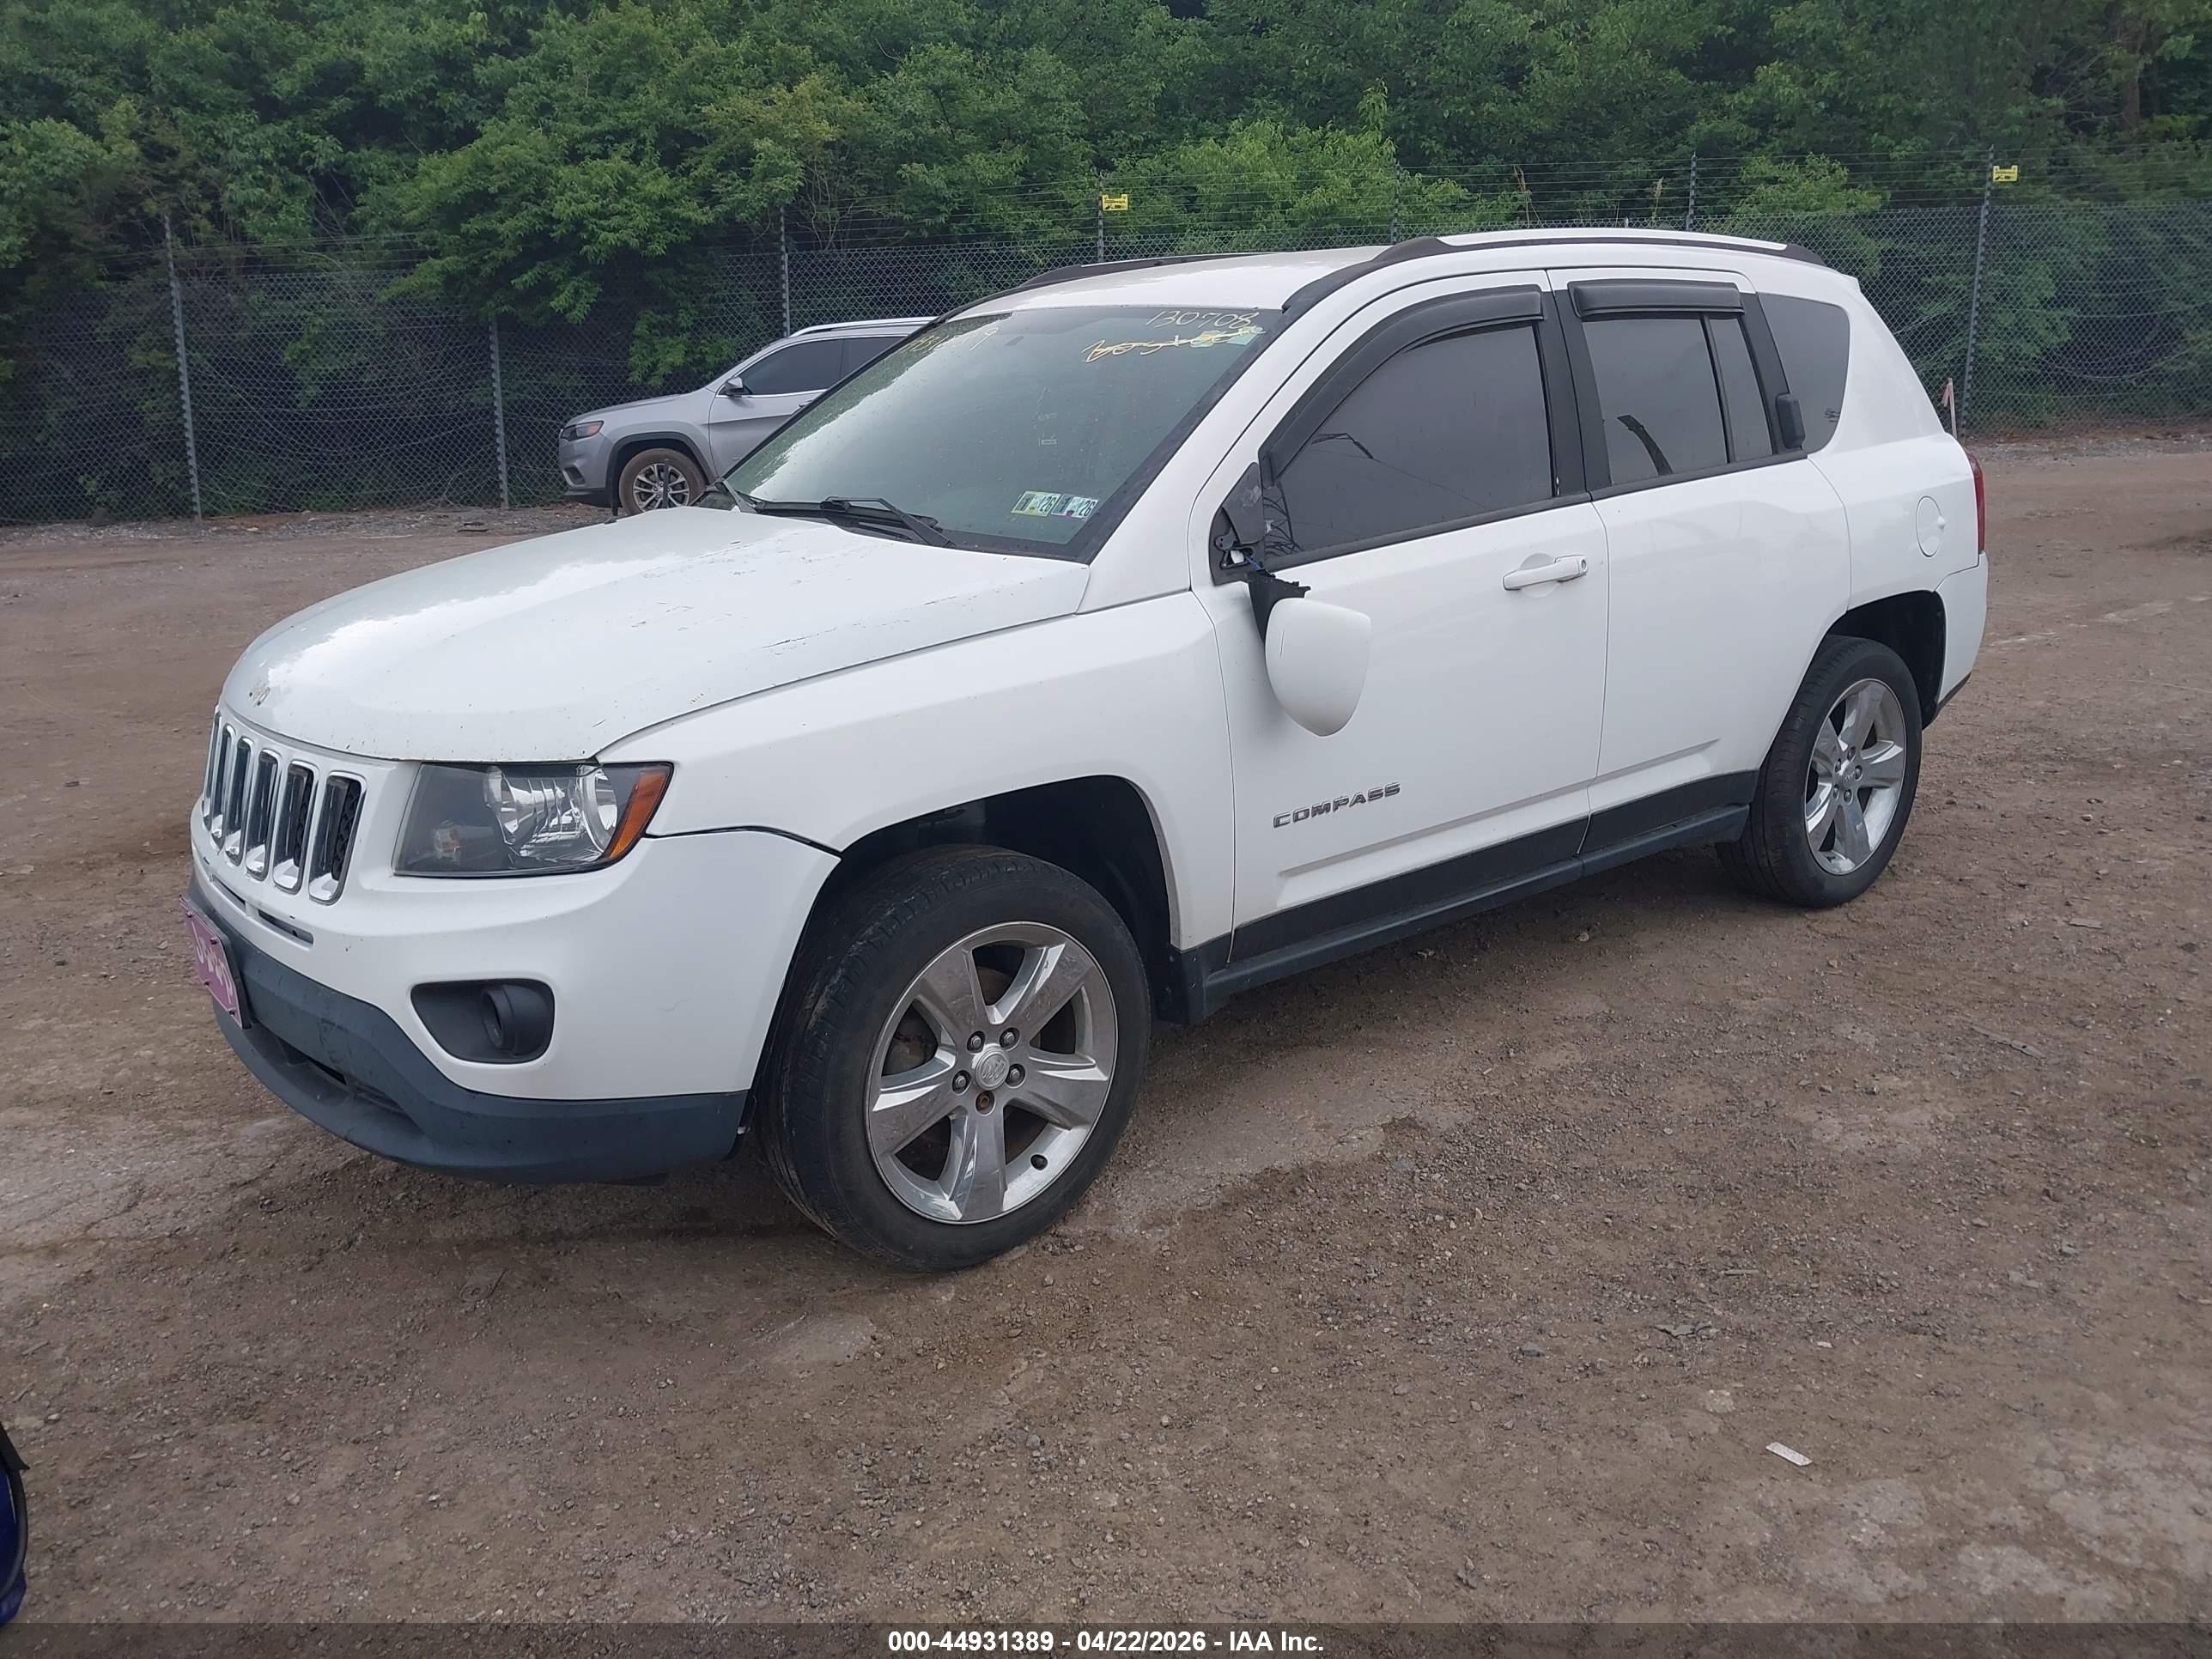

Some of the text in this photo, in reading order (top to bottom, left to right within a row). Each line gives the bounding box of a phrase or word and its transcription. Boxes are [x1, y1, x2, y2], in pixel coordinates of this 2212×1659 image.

[1146, 310, 1260, 329] 130708
[1040, 495, 1056, 513] 26
[1079, 500, 1096, 517] 26
[1273, 781, 1401, 829] COMPASS
